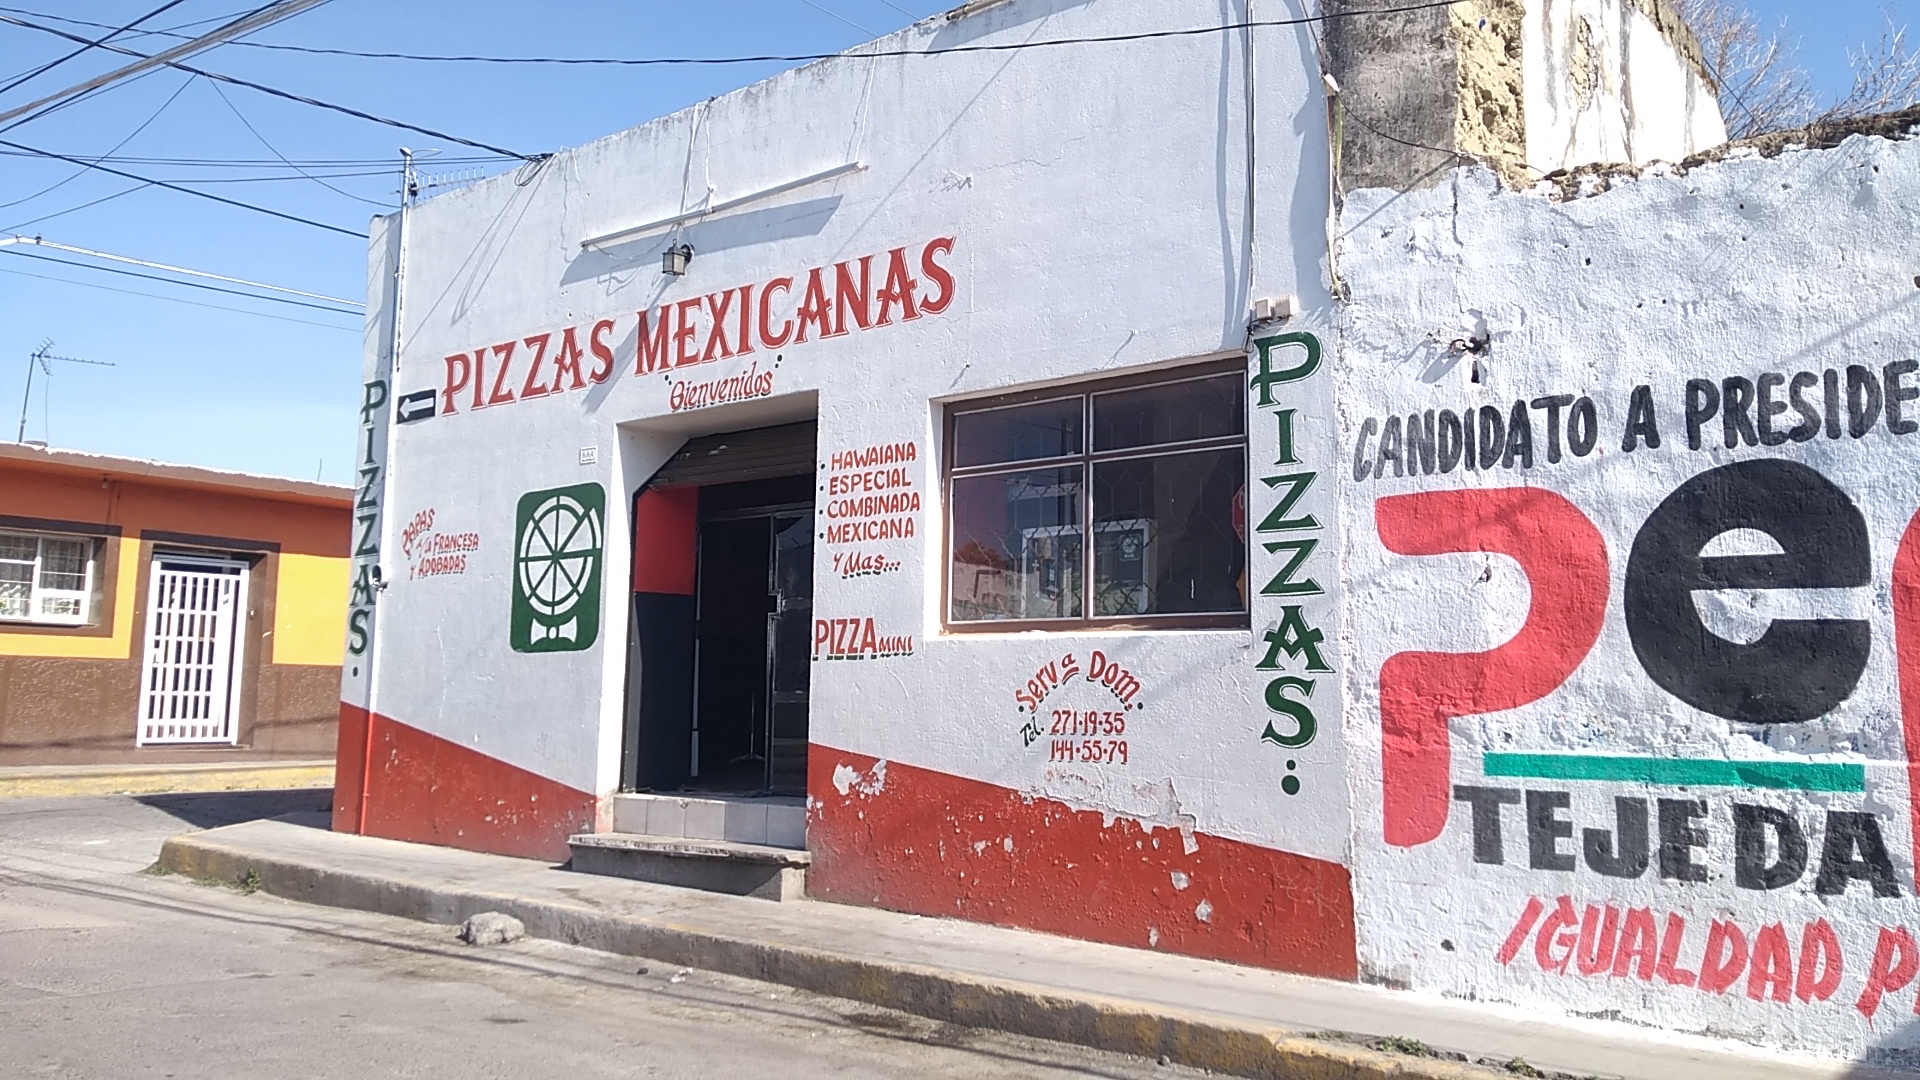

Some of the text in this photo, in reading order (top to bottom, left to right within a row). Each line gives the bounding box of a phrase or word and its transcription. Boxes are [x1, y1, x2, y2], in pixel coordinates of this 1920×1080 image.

[440, 236, 957, 417] PIZZAS MEXICANAS
[670, 361, 773, 412] Bienvenidos
[1353, 359, 1920, 482] CANDIDATO A PRESIDE
[829, 467, 912, 495] ESPECIAL
[831, 441, 916, 471] HAWAIANA
[348, 379, 387, 655] PIZZAS
[827, 492, 921, 519] COMBINADA
[827, 517, 914, 544] MEXICANA
[402, 508, 436, 558] PAPAS
[433, 533, 479, 556] FRANCESA
[1250, 331, 1336, 750] PIZZAS
[418, 554, 467, 578] ADOBADAS
[815, 617, 877, 656] PIZZA
[1015, 661, 1058, 711] Serv
[1376, 457, 1920, 896] Pe
[1019, 716, 1045, 747] Tel.
[1453, 784, 1901, 898] TEJEDA
[1497, 895, 1920, 1020] IGUALDAD P
